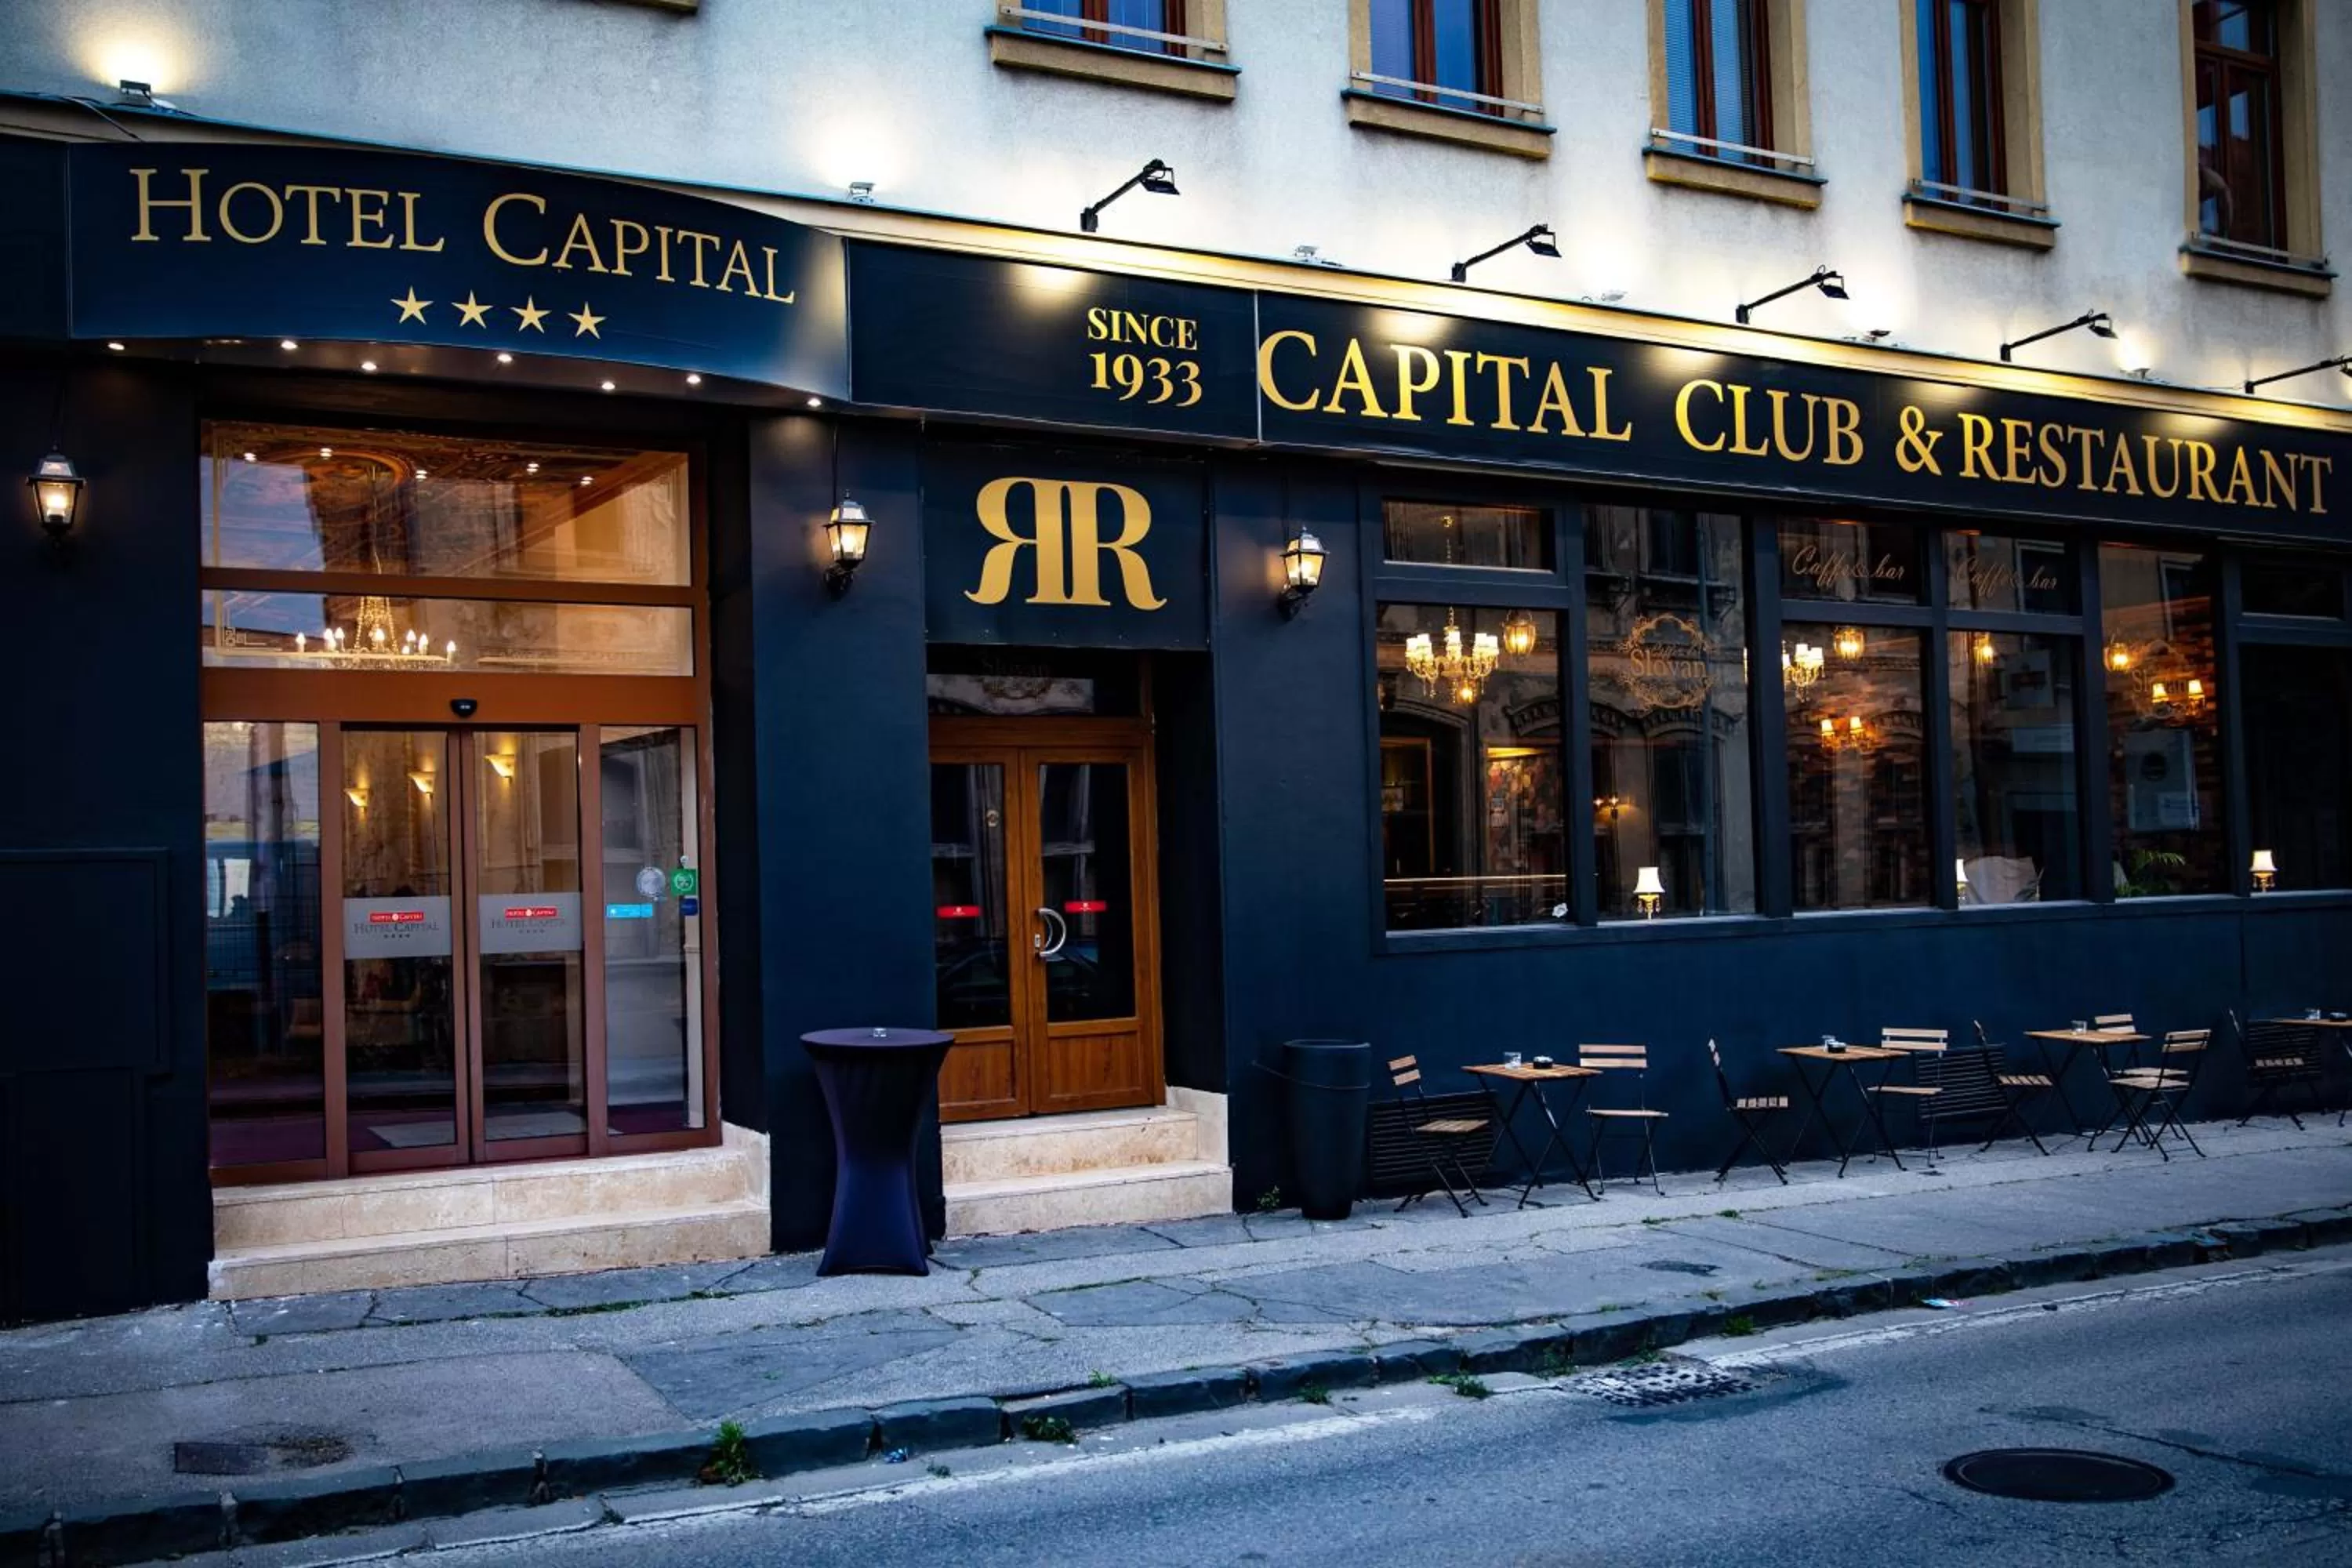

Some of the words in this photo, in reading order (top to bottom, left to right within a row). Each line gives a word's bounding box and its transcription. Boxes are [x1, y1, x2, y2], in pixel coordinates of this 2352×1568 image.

[129, 168, 445, 253] HOTEL
[483, 192, 794, 304] CAPITAL
[1087, 307, 1198, 350] SINCE
[1089, 352, 1203, 406] 1933
[1258, 329, 1632, 441] CAPITAL
[1675, 379, 1864, 465] CLUB
[1894, 405, 1944, 476] &
[1958, 412, 2333, 514] RESTAURANT
[1870, 552, 1906, 582] bar
[2026, 564, 2058, 590] bar
[1630, 648, 1706, 680] Slovan
